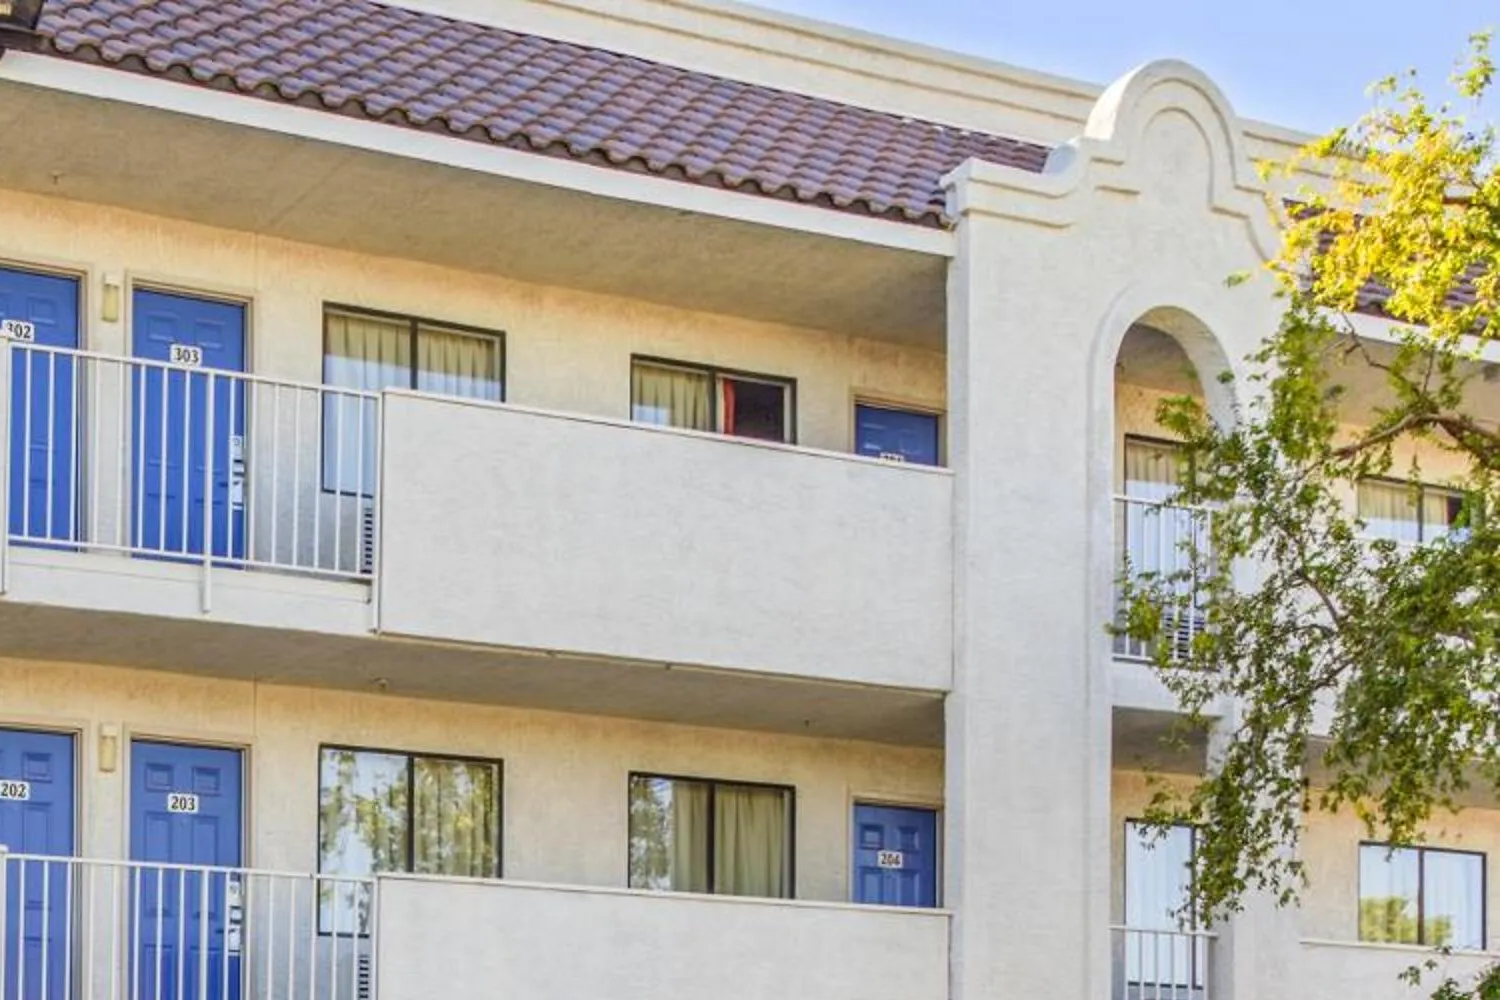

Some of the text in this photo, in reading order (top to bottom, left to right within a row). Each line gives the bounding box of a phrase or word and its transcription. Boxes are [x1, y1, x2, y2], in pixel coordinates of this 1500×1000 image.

[173, 347, 199, 363] 303
[0, 782, 26, 798] 202
[171, 795, 195, 811] 203
